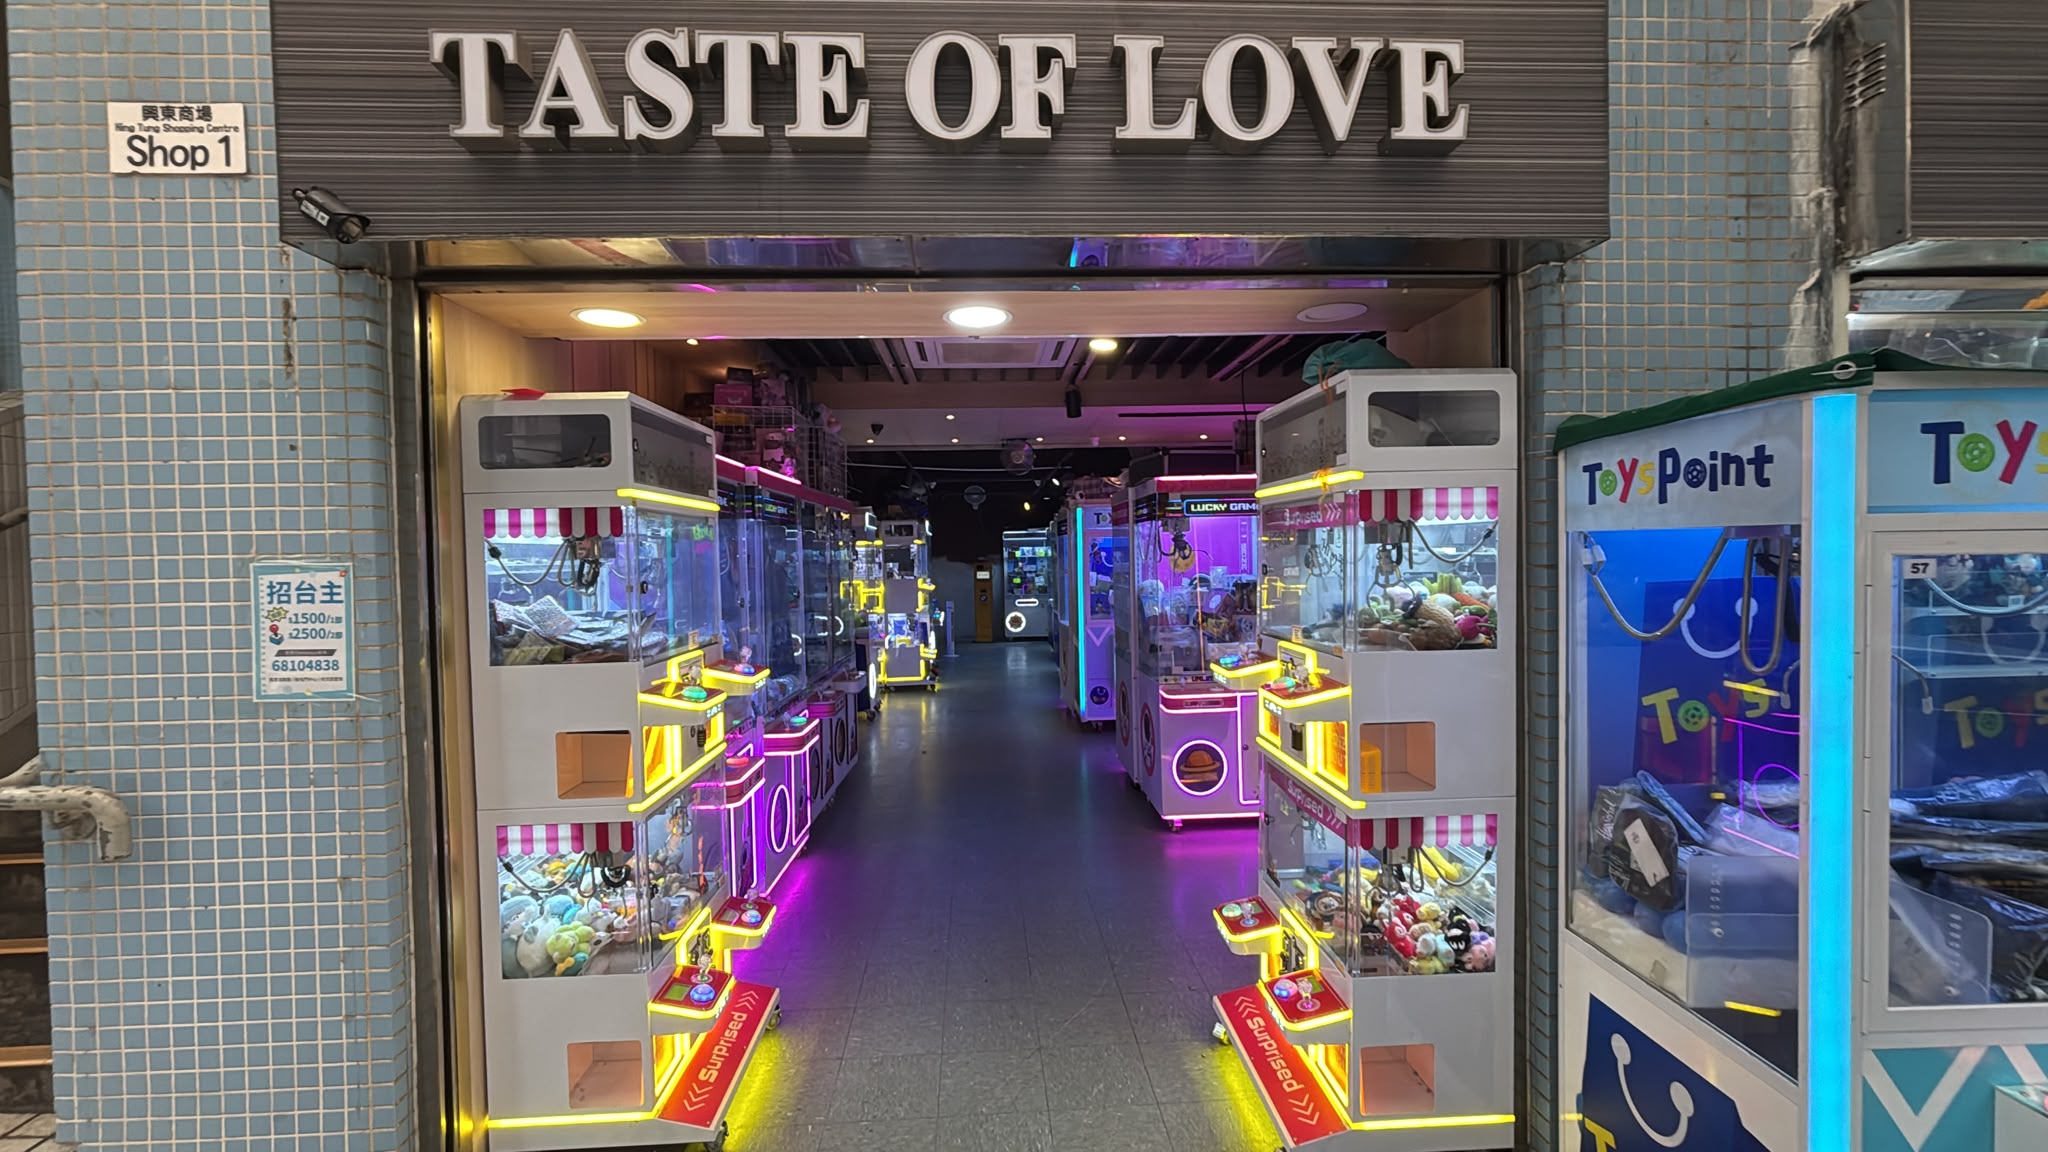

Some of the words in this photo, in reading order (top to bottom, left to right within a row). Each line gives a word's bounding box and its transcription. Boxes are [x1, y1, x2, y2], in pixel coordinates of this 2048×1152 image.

[428, 27, 870, 140] TASTE
[905, 30, 1076, 140] OF
[1113, 33, 1470, 142] LOVE
[142, 105, 212, 121] 興東商場
[138, 123, 160, 133] Tung
[163, 124, 204, 133] Shopping
[207, 124, 239, 133] Centre
[127, 134, 209, 170] Shop
[218, 135, 231, 167] 1
[1190, 503, 1228, 512] LUCKY
[1910, 562, 1930, 574] 57
[266, 580, 344, 605] 招台主
[271, 660, 340, 671] 68104838
